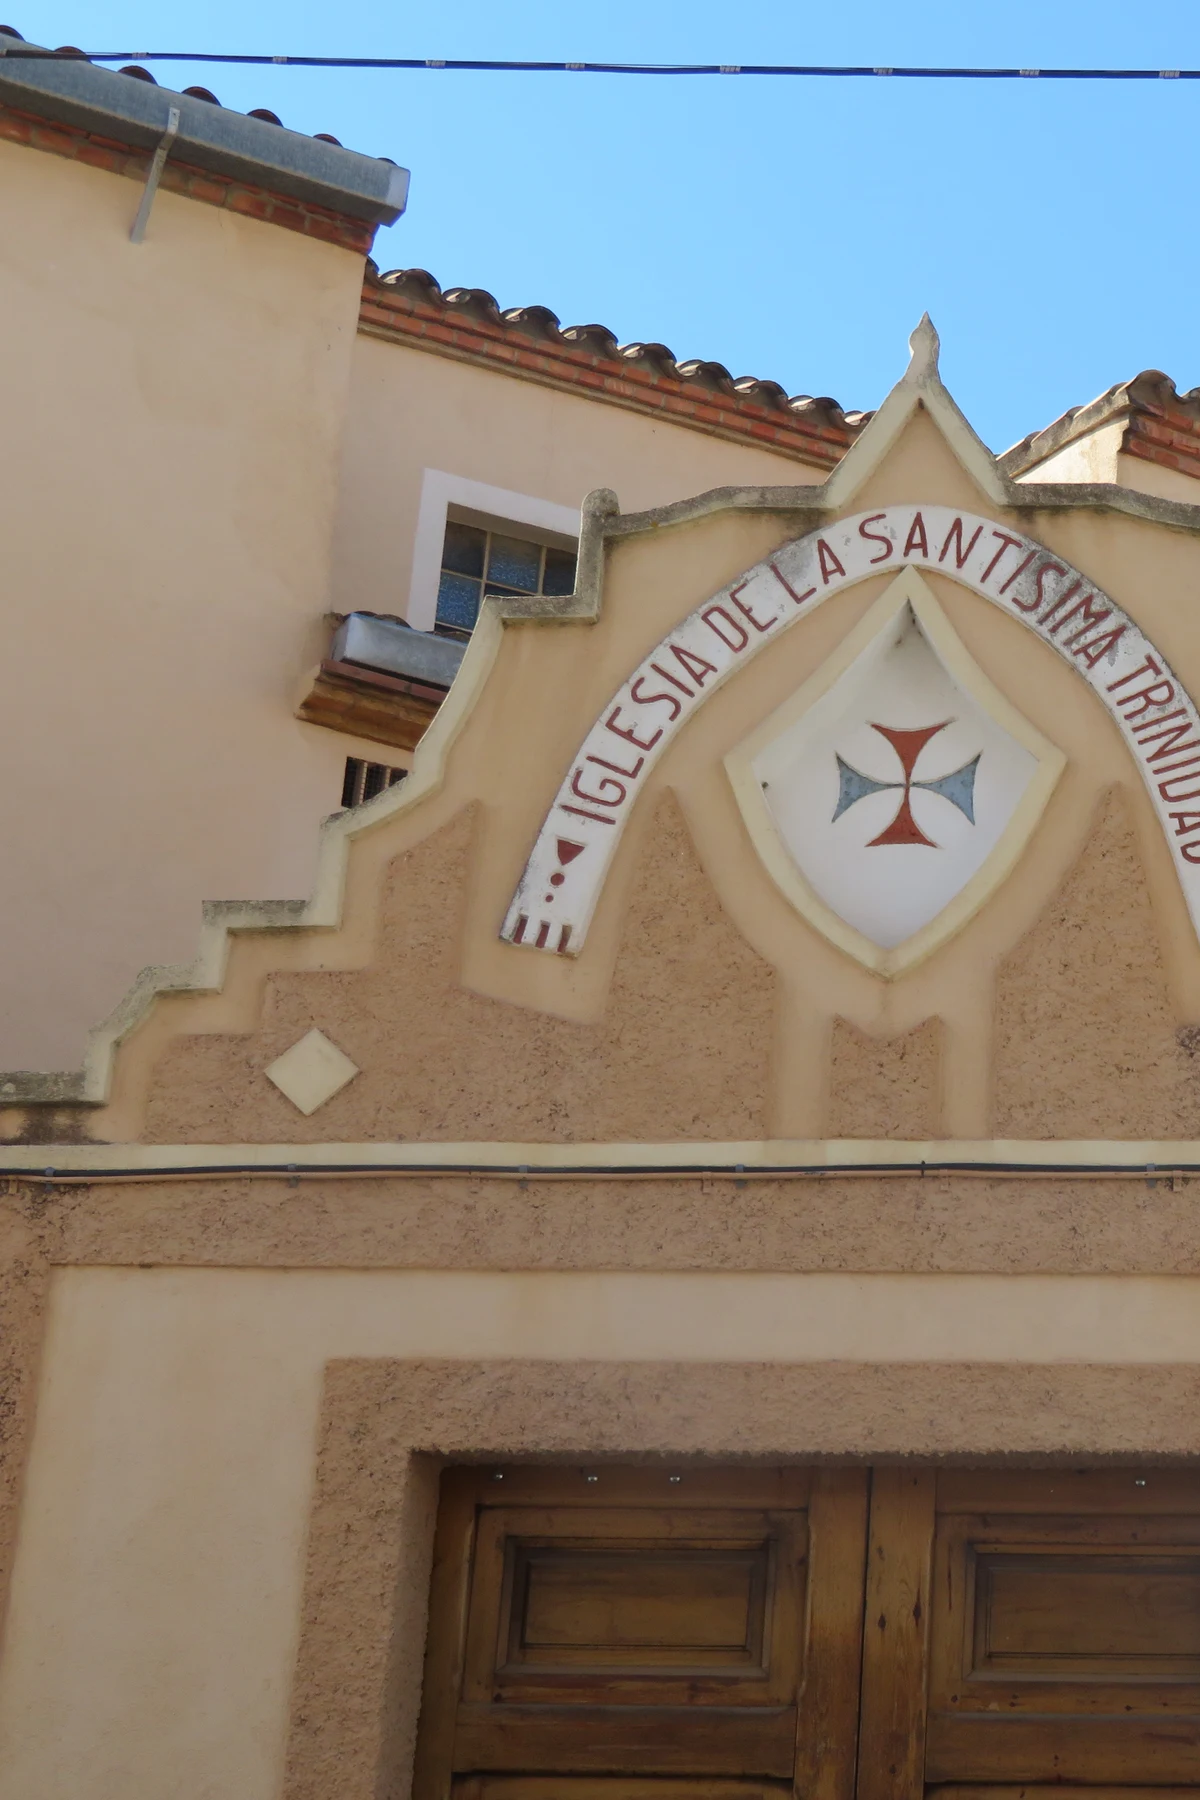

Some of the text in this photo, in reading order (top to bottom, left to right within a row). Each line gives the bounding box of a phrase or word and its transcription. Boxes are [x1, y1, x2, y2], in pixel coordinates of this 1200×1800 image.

[560, 645, 718, 825] IGLESIA
[701, 583, 778, 653] DE
[770, 538, 846, 604] LA
[858, 511, 1127, 669] SANTISIMA
